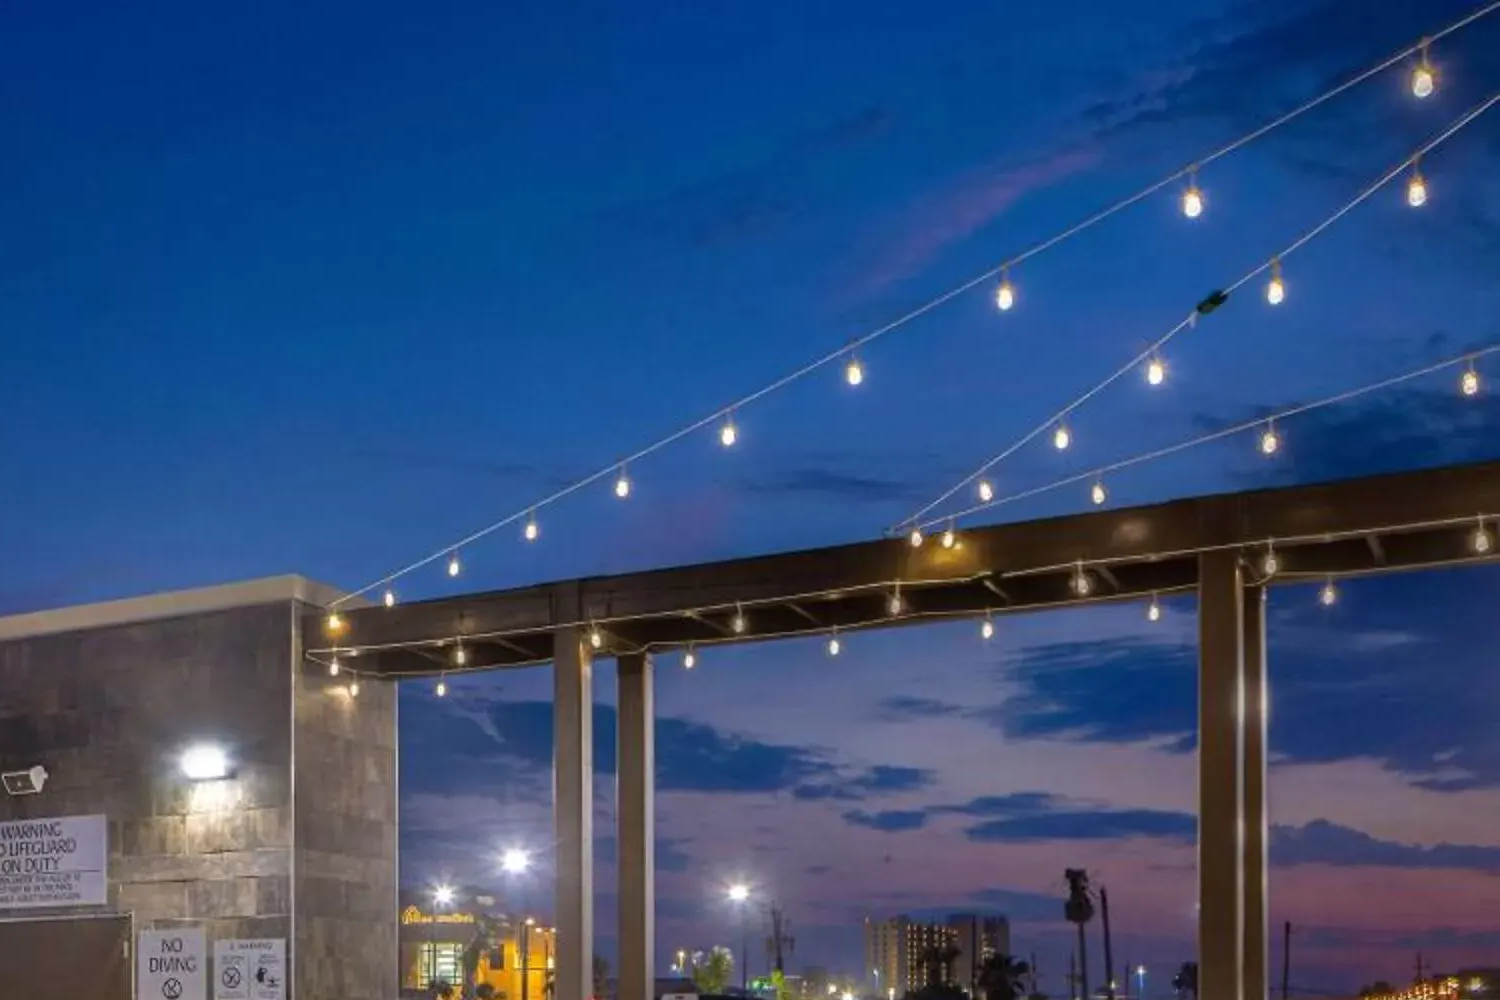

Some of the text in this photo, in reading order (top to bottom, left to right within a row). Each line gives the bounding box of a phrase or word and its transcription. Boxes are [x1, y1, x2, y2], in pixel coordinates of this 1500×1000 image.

[1, 821, 62, 840] WARNING
[9, 837, 77, 856] LIFEGUARD
[1, 857, 59, 874] ON DUTY
[161, 937, 183, 953] NO
[149, 956, 197, 973] DIVING
